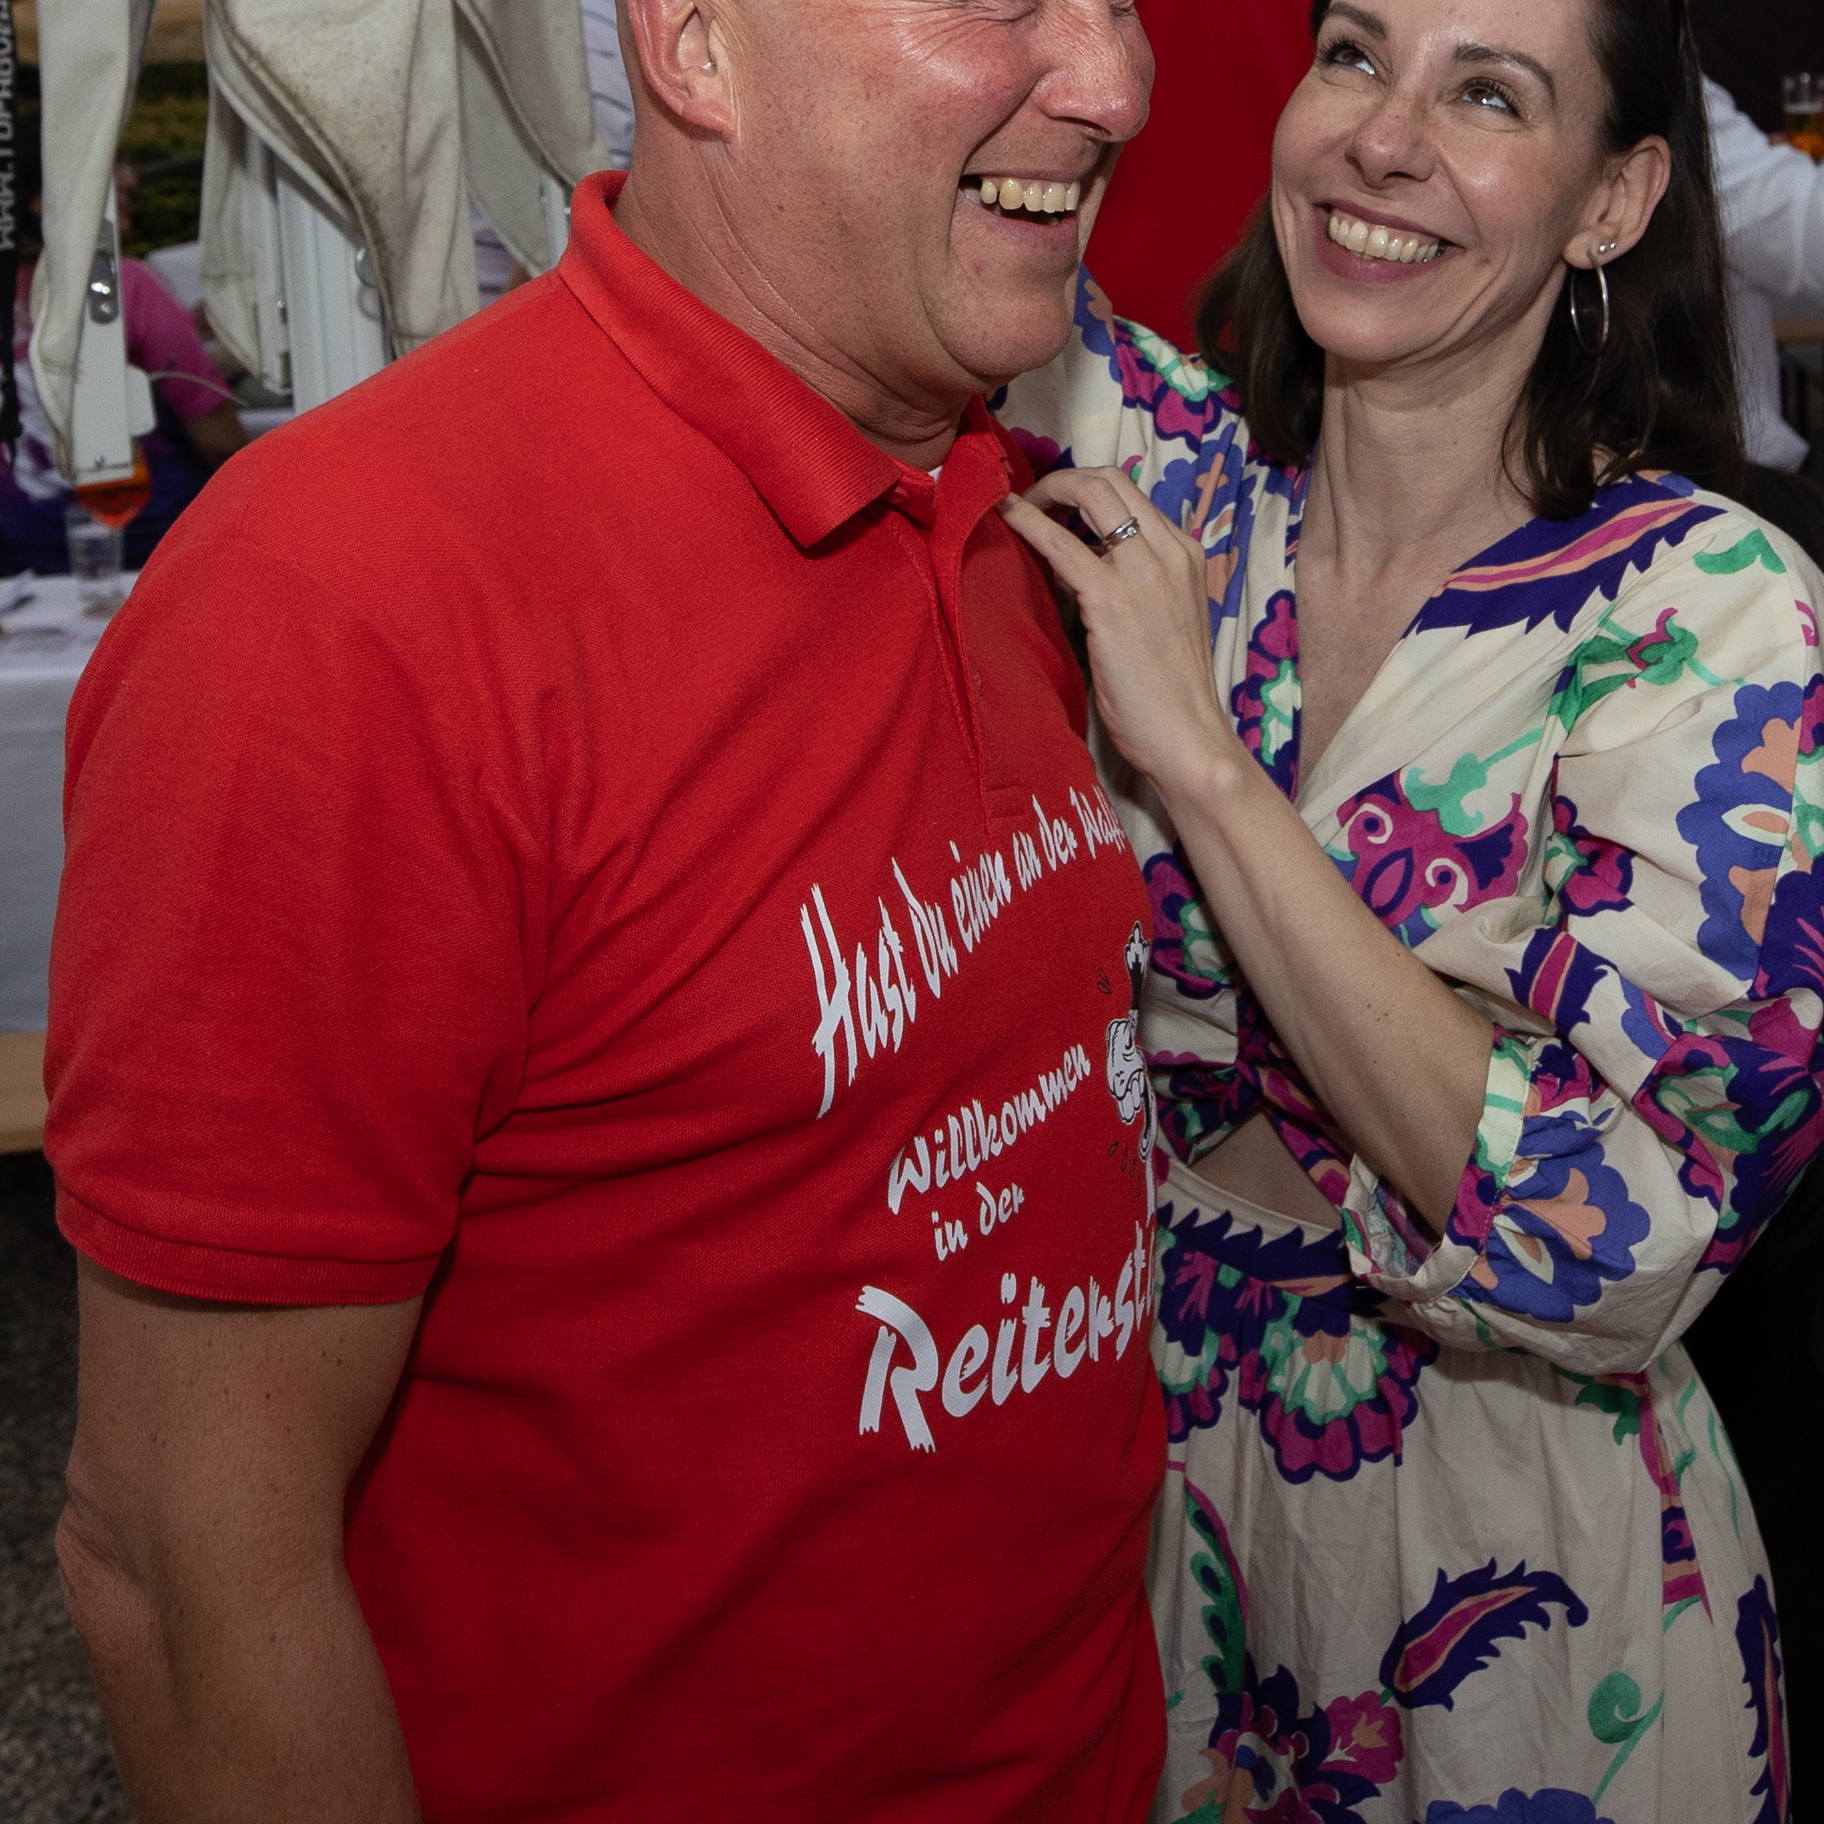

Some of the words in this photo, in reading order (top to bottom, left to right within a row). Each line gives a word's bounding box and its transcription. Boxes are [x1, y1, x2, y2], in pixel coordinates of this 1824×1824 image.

[800, 882, 916, 1120] Hast
[948, 839, 1012, 954] einen
[1012, 830, 1043, 893] an
[1031, 793, 1078, 872] der
[1068, 784, 1126, 861] Waff
[887, 1043, 1092, 1216] Willkommen
[931, 1210, 969, 1262] in
[976, 1181, 1025, 1236] der
[853, 1219, 1156, 1454] Reiterst
